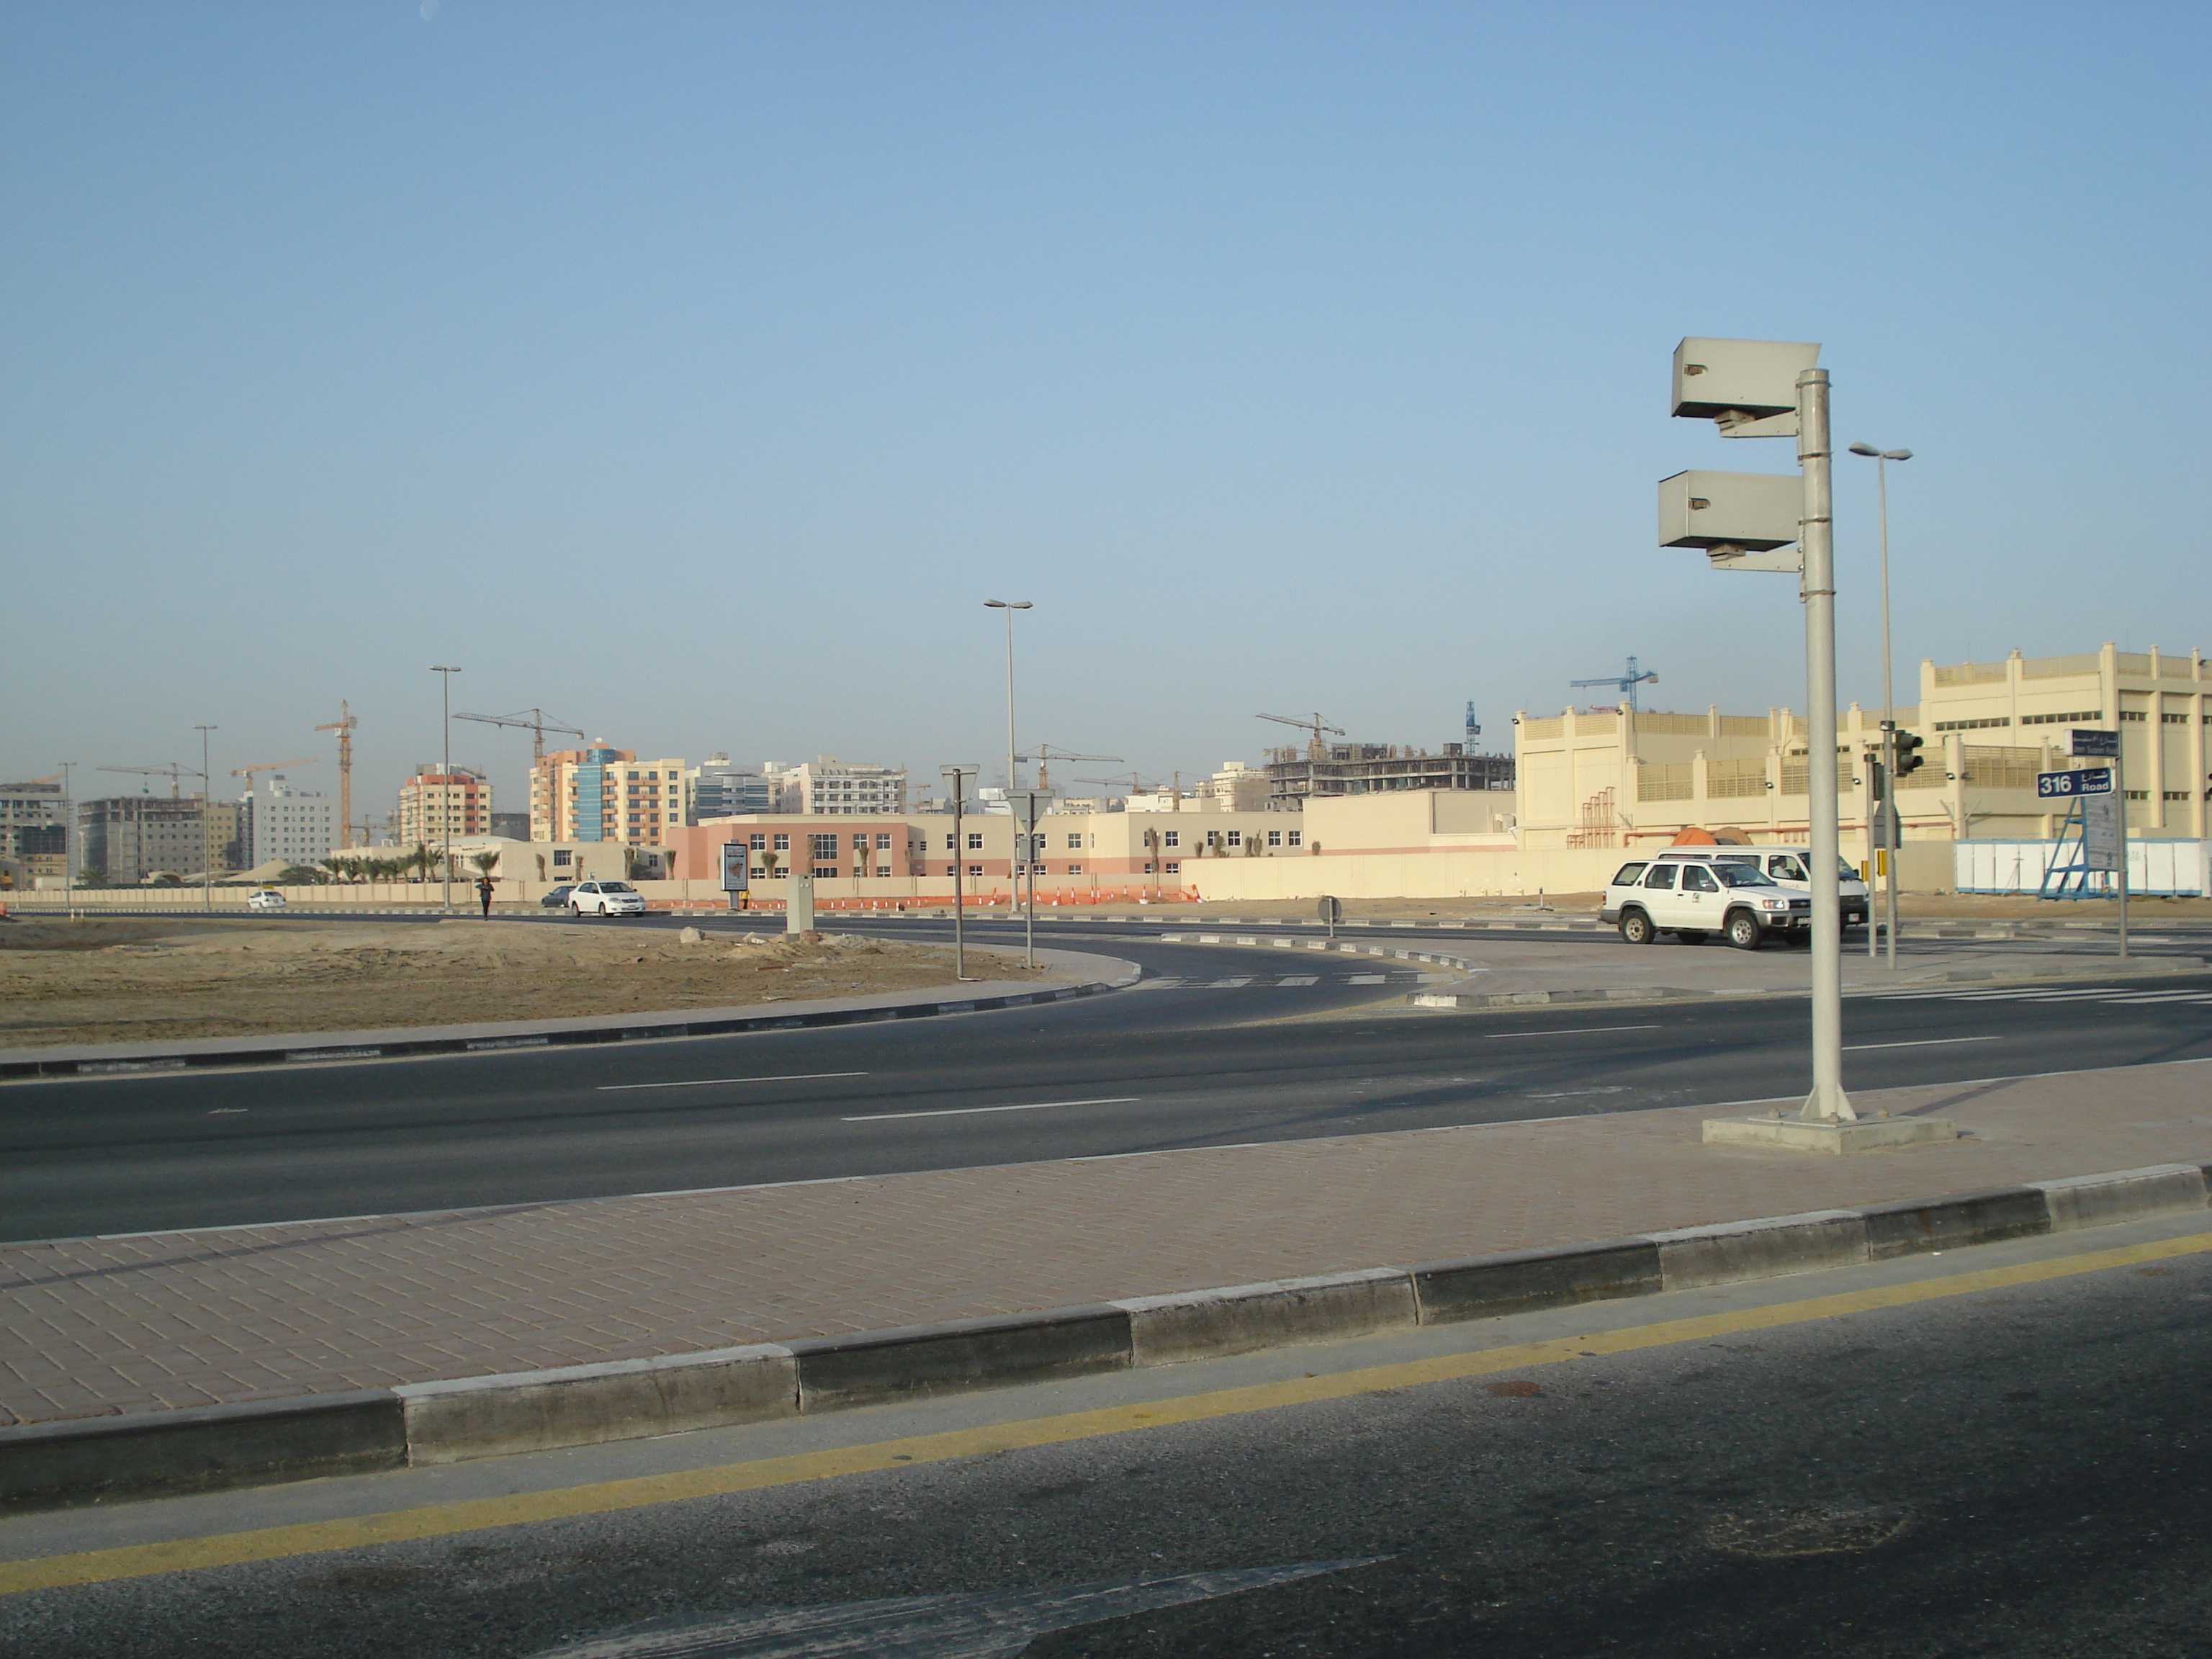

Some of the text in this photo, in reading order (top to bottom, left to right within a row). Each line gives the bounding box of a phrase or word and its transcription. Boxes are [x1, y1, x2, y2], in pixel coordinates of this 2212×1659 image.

[2082, 770, 2108, 782] شارع
[2040, 775, 2072, 794] 316
[2082, 781, 2109, 792] Road
